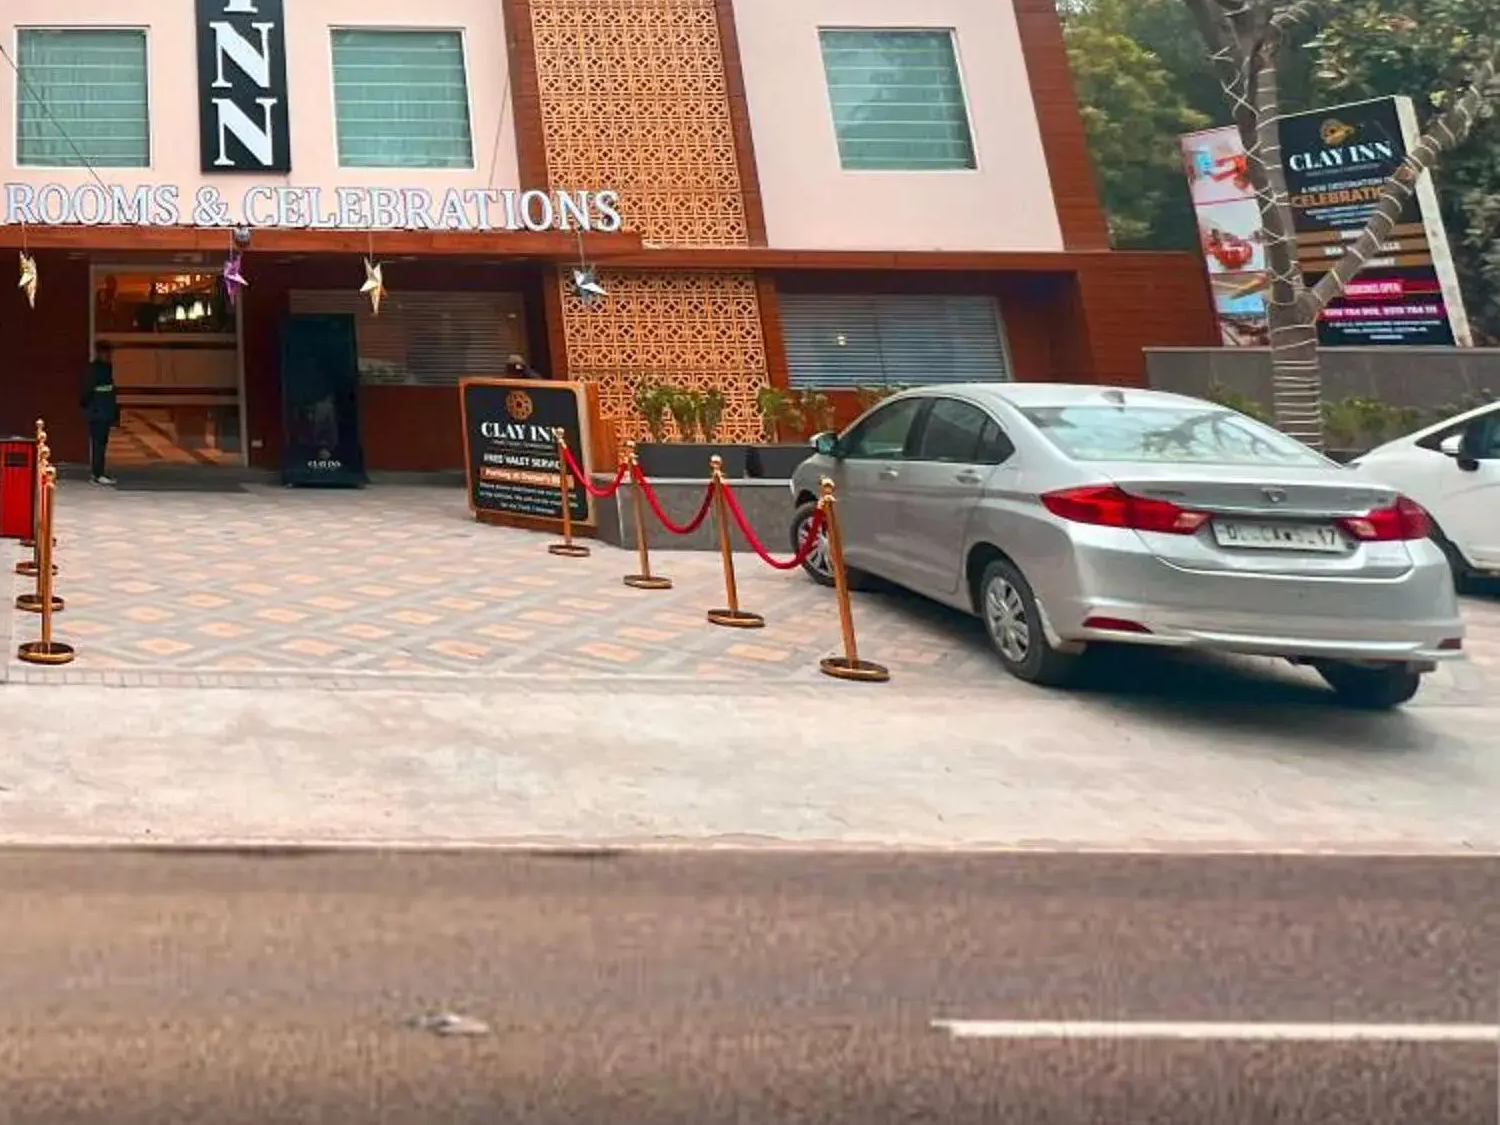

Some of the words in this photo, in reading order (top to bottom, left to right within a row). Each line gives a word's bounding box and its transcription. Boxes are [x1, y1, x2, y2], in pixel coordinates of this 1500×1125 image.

[1289, 148, 1343, 171] CLAY
[1349, 141, 1392, 163] INN
[4, 183, 180, 225] ROOMS
[193, 186, 232, 227] &
[245, 186, 622, 232] CELEBRATIONS
[480, 422, 526, 440] CLAY
